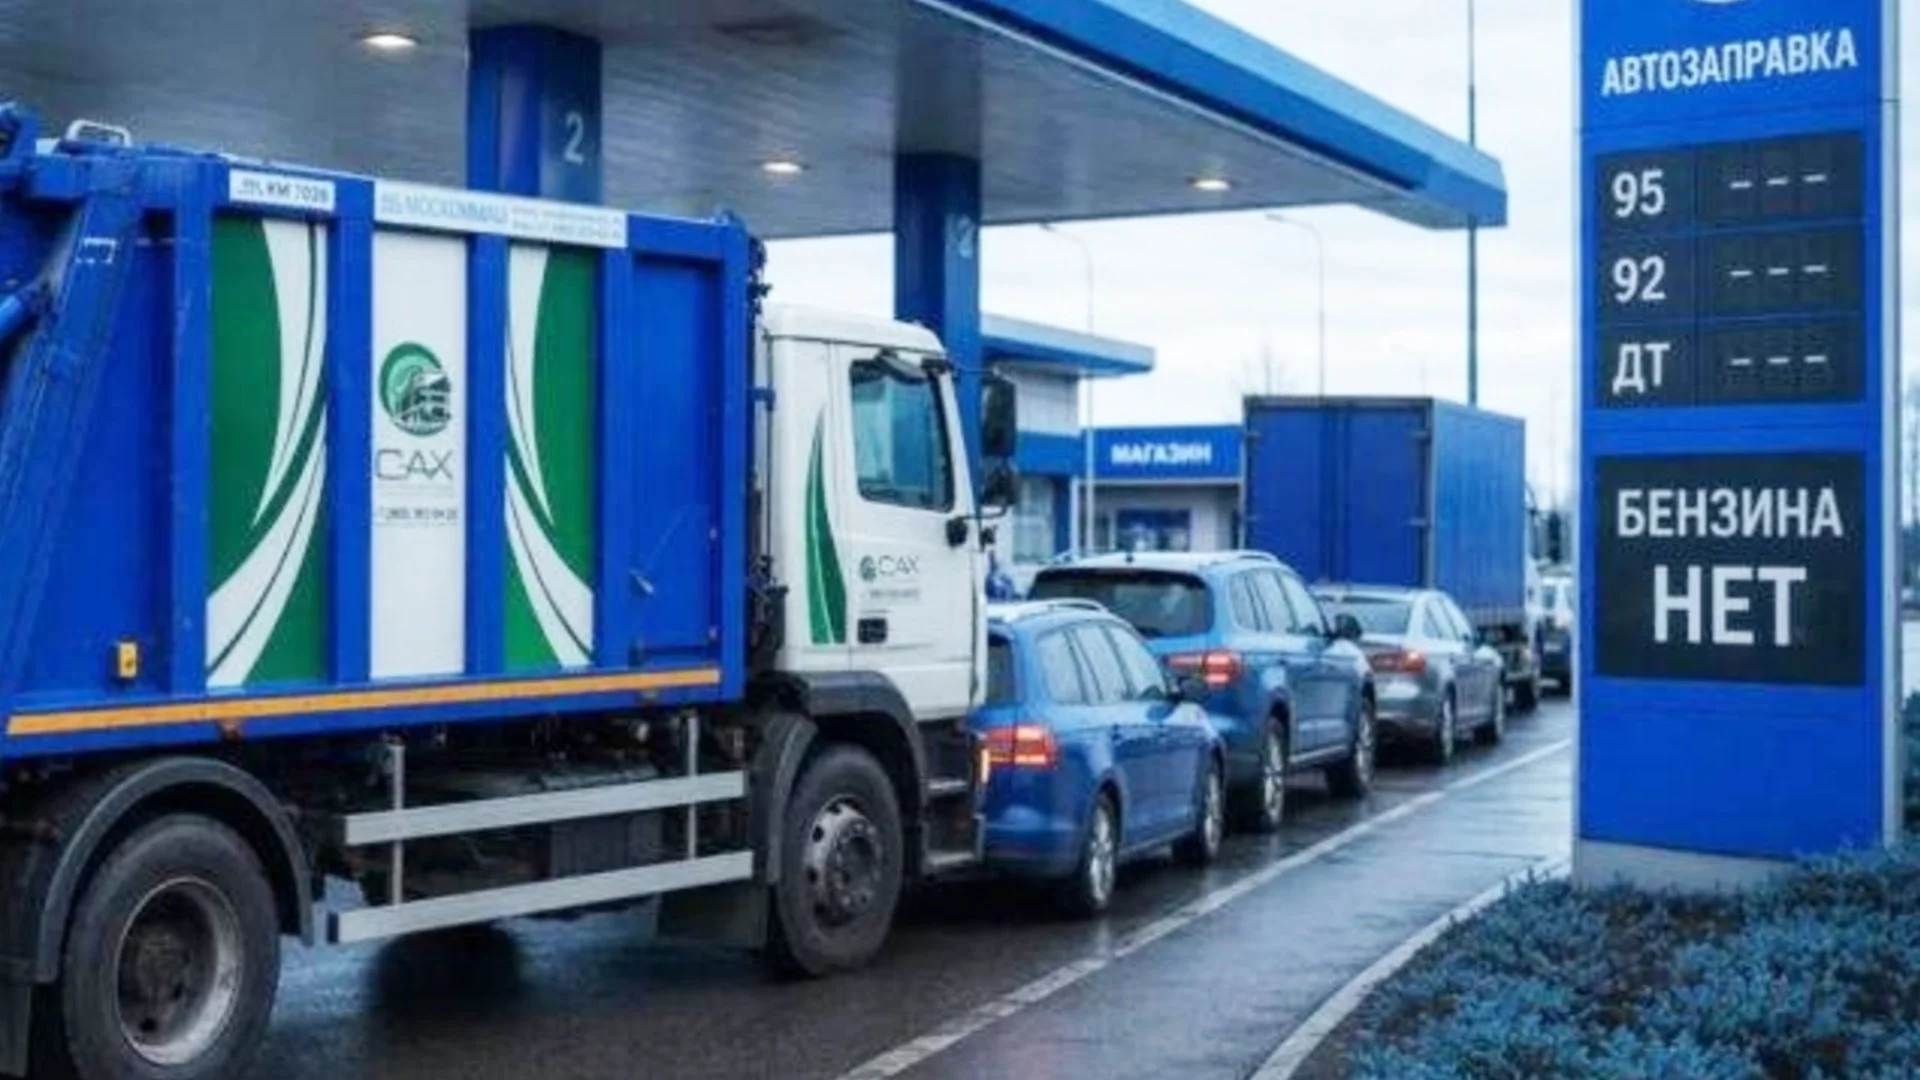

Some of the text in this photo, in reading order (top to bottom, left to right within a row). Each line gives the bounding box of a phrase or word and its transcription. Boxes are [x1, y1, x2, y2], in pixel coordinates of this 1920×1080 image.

[1602, 28, 1858, 97] АВТОЗАПРАВКА
[564, 110, 585, 165] 2
[1612, 169, 1666, 219] 95
[1612, 256, 1667, 302] 92
[1612, 342, 1670, 394] ДТ
[375, 448, 454, 482] САХ
[1110, 441, 1213, 466] МАГАЗИН
[1617, 486, 1844, 538] БЕНЗИНА
[1654, 564, 1808, 647] НЕТ
